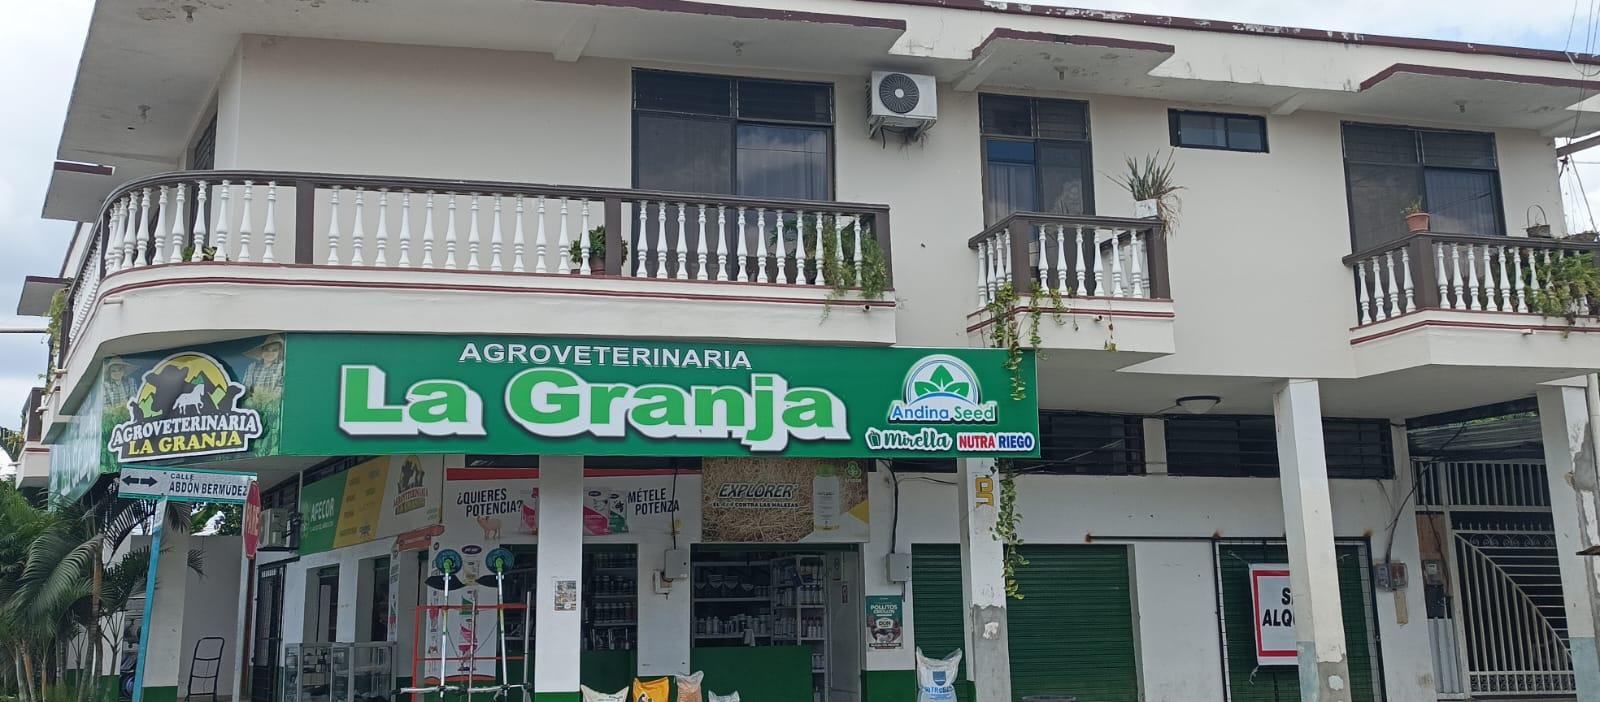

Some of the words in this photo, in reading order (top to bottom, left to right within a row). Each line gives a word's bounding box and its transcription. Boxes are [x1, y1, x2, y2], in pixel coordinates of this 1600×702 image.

[459, 342, 752, 369] AGROVETERINARIA
[339, 365, 482, 433] La
[507, 367, 846, 448] Granja
[892, 405, 949, 420] Andina
[954, 405, 994, 420] Seed
[112, 412, 259, 446] AGROVETERINARIA
[129, 439, 154, 455] LA
[158, 431, 242, 453] GRANJA
[884, 429, 950, 448] Mirella
[959, 435, 996, 449] NUTRA
[999, 435, 1033, 449] RIEGO
[170, 472, 194, 481] CALLE
[169, 479, 200, 494] ABDÓN
[201, 481, 248, 497] BERMÚDEZ
[457, 488, 508, 505] ¿QUIERES
[627, 488, 667, 503] MÉTELE
[718, 483, 795, 498] EXPLORER
[466, 500, 524, 517] POTENCIA?
[635, 499, 680, 516] POTENZA
[1281, 587, 1294, 606] S
[1262, 608, 1296, 627] ALQ
